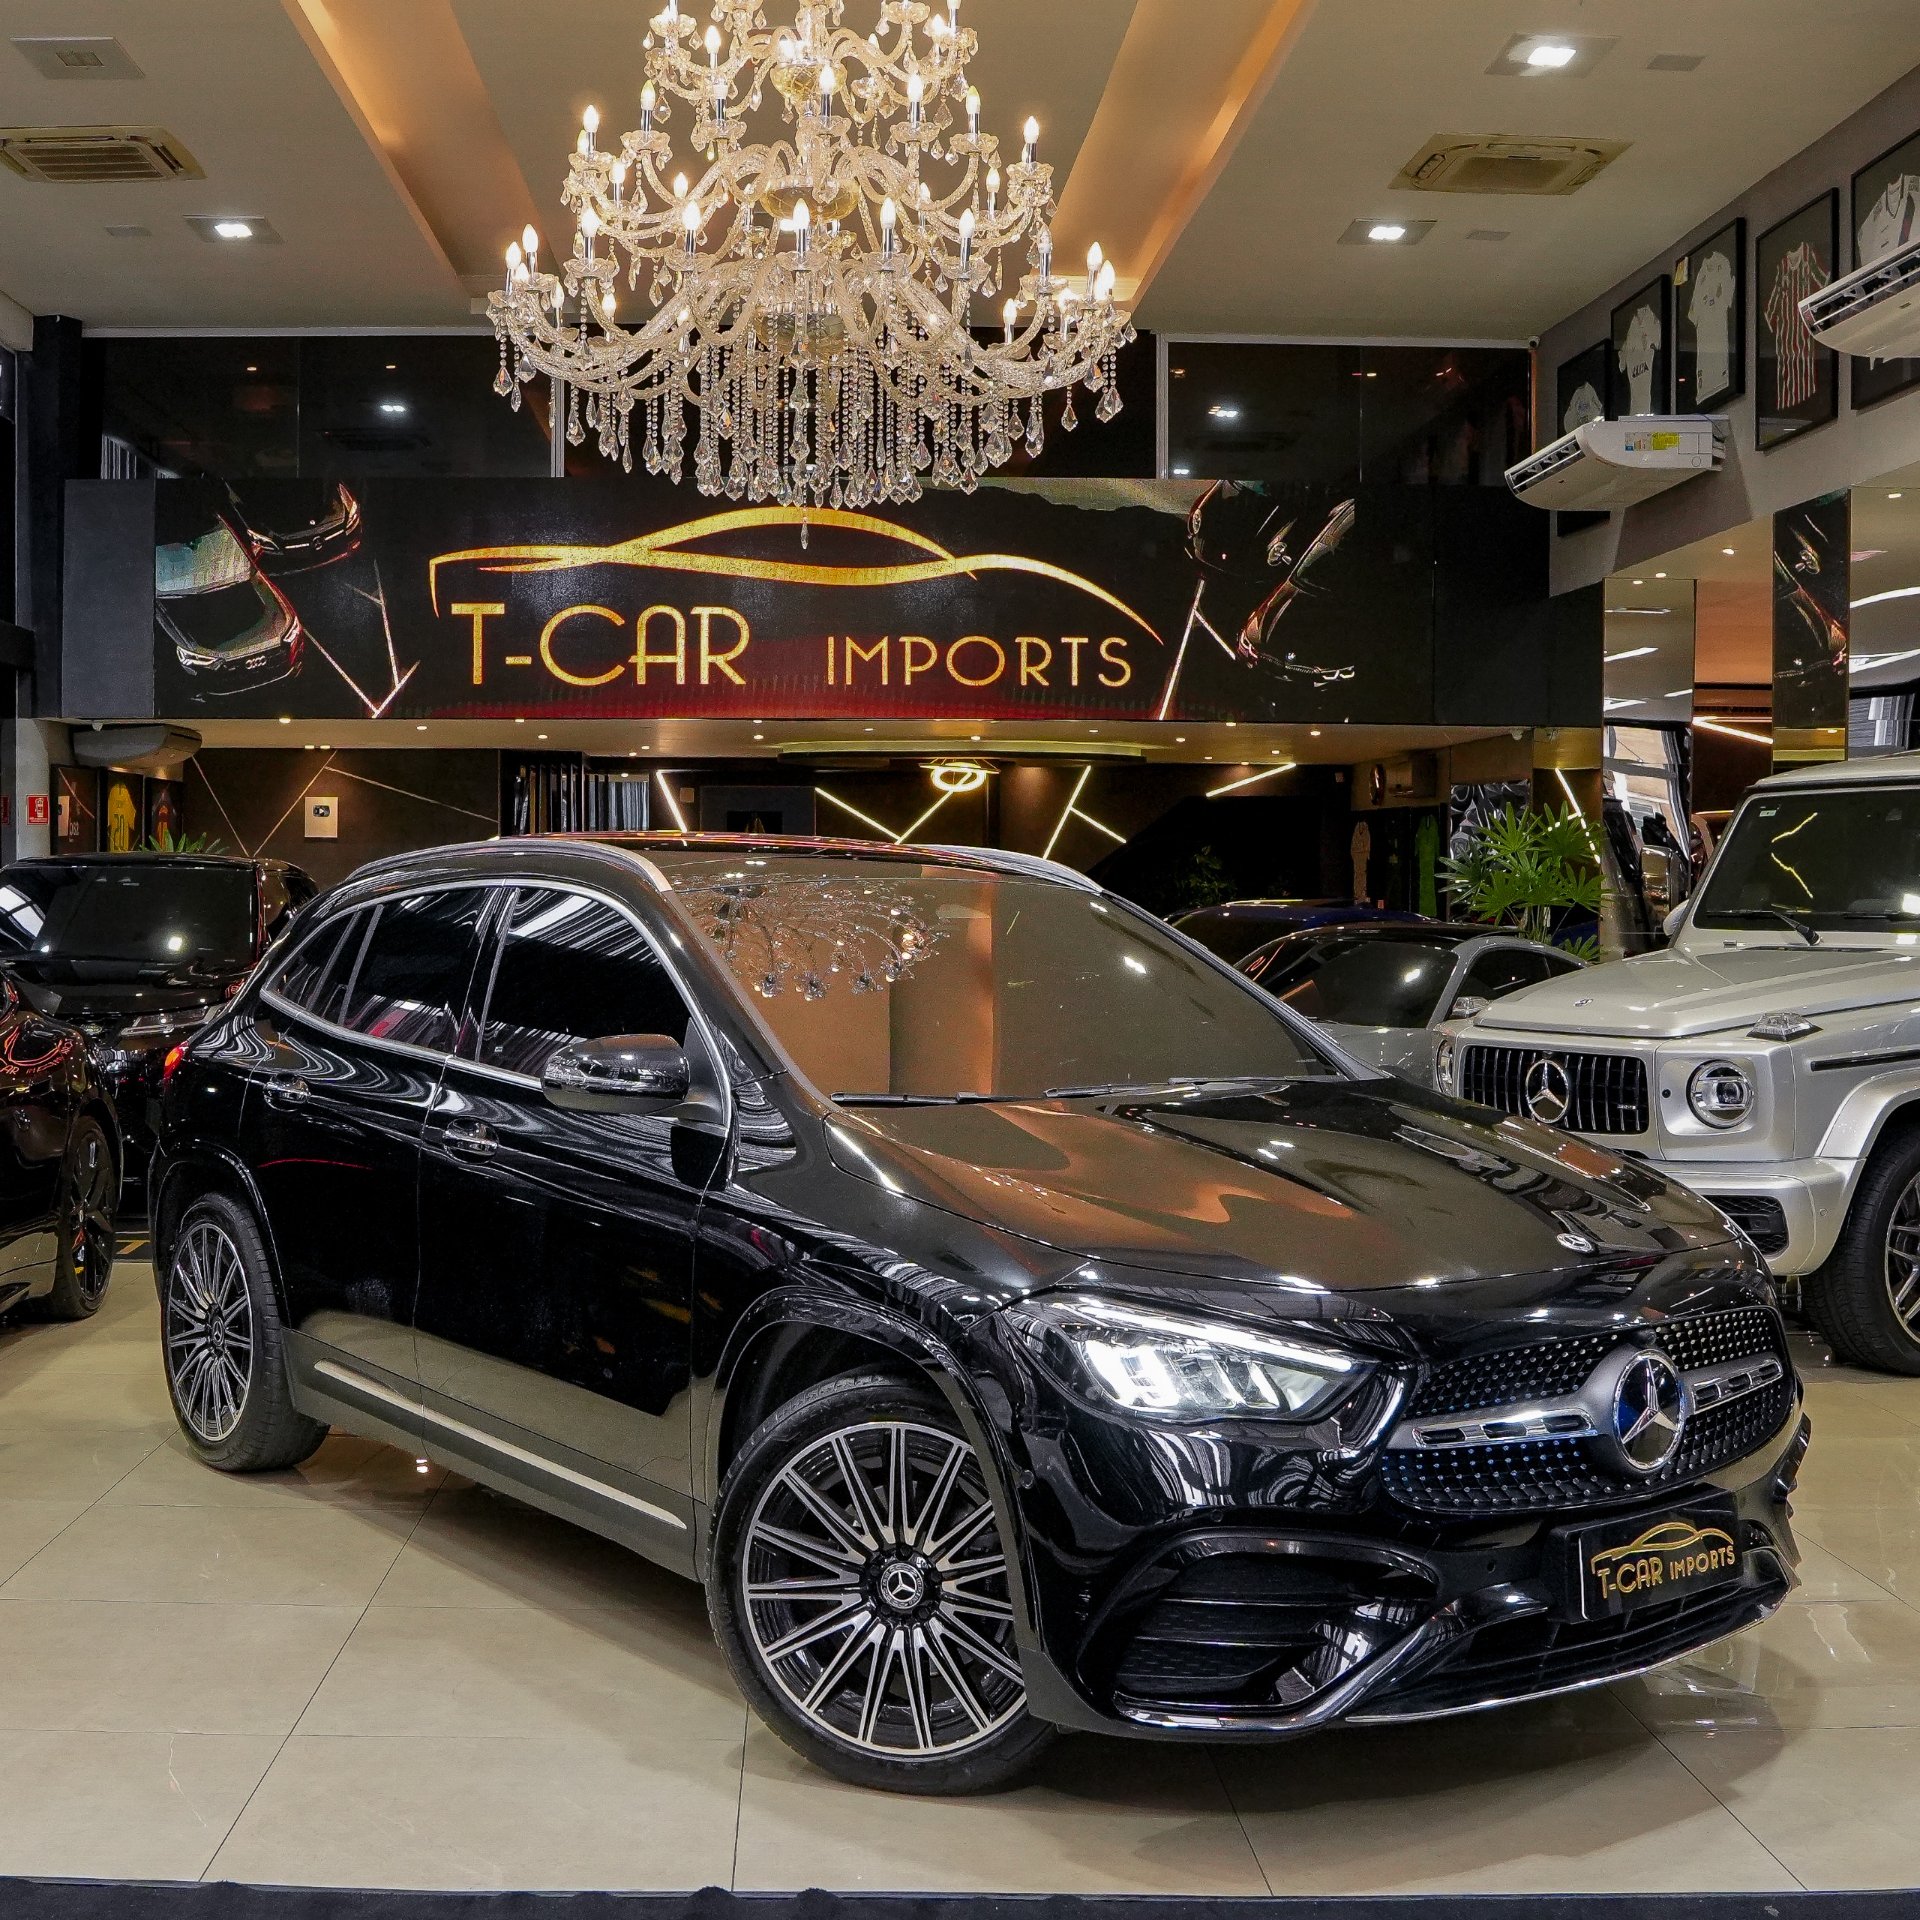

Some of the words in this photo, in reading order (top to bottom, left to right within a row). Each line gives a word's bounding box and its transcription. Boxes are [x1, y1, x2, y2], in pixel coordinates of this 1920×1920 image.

[450, 602, 751, 687] T-CAR
[827, 635, 1132, 687] IMPORTS
[1596, 1556, 1664, 1600] T-CAR
[1669, 1545, 1736, 1581] IMPORTS
